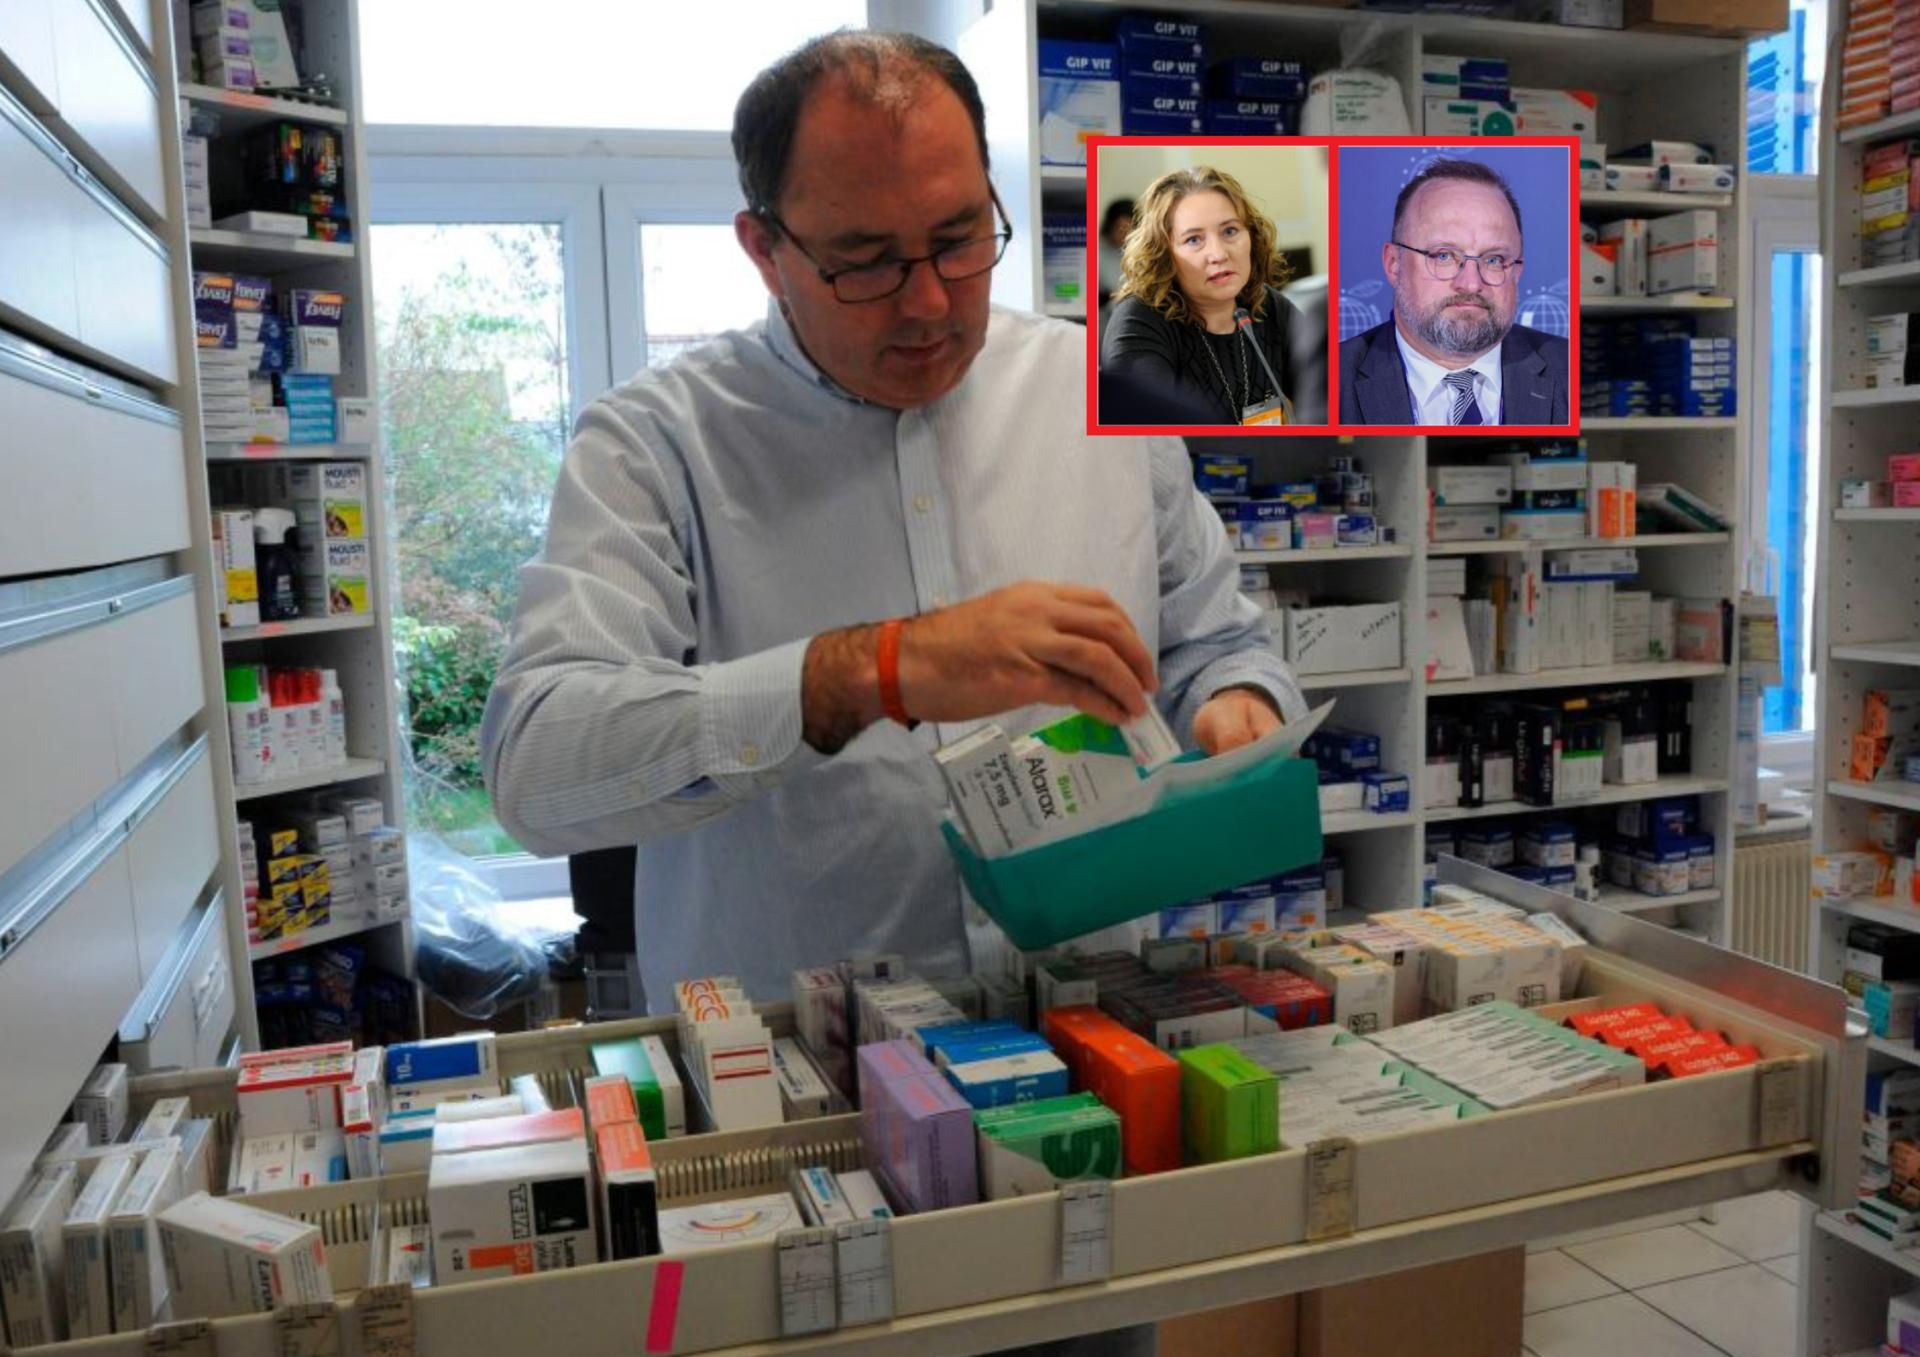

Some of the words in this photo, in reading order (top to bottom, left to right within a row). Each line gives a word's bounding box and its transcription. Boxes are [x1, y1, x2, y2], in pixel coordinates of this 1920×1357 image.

[1154, 22, 1177, 34] GIP
[1066, 56, 1089, 69] GIP
[1092, 57, 1112, 71] VIT
[1153, 60, 1175, 73] GIP
[1178, 61, 1197, 74] VIT
[1261, 61, 1281, 73] GIP
[1153, 98, 1175, 110] GIP
[1178, 99, 1198, 112] VIT
[1237, 102, 1259, 114] GIP
[508, 1183, 531, 1240] TEVA
